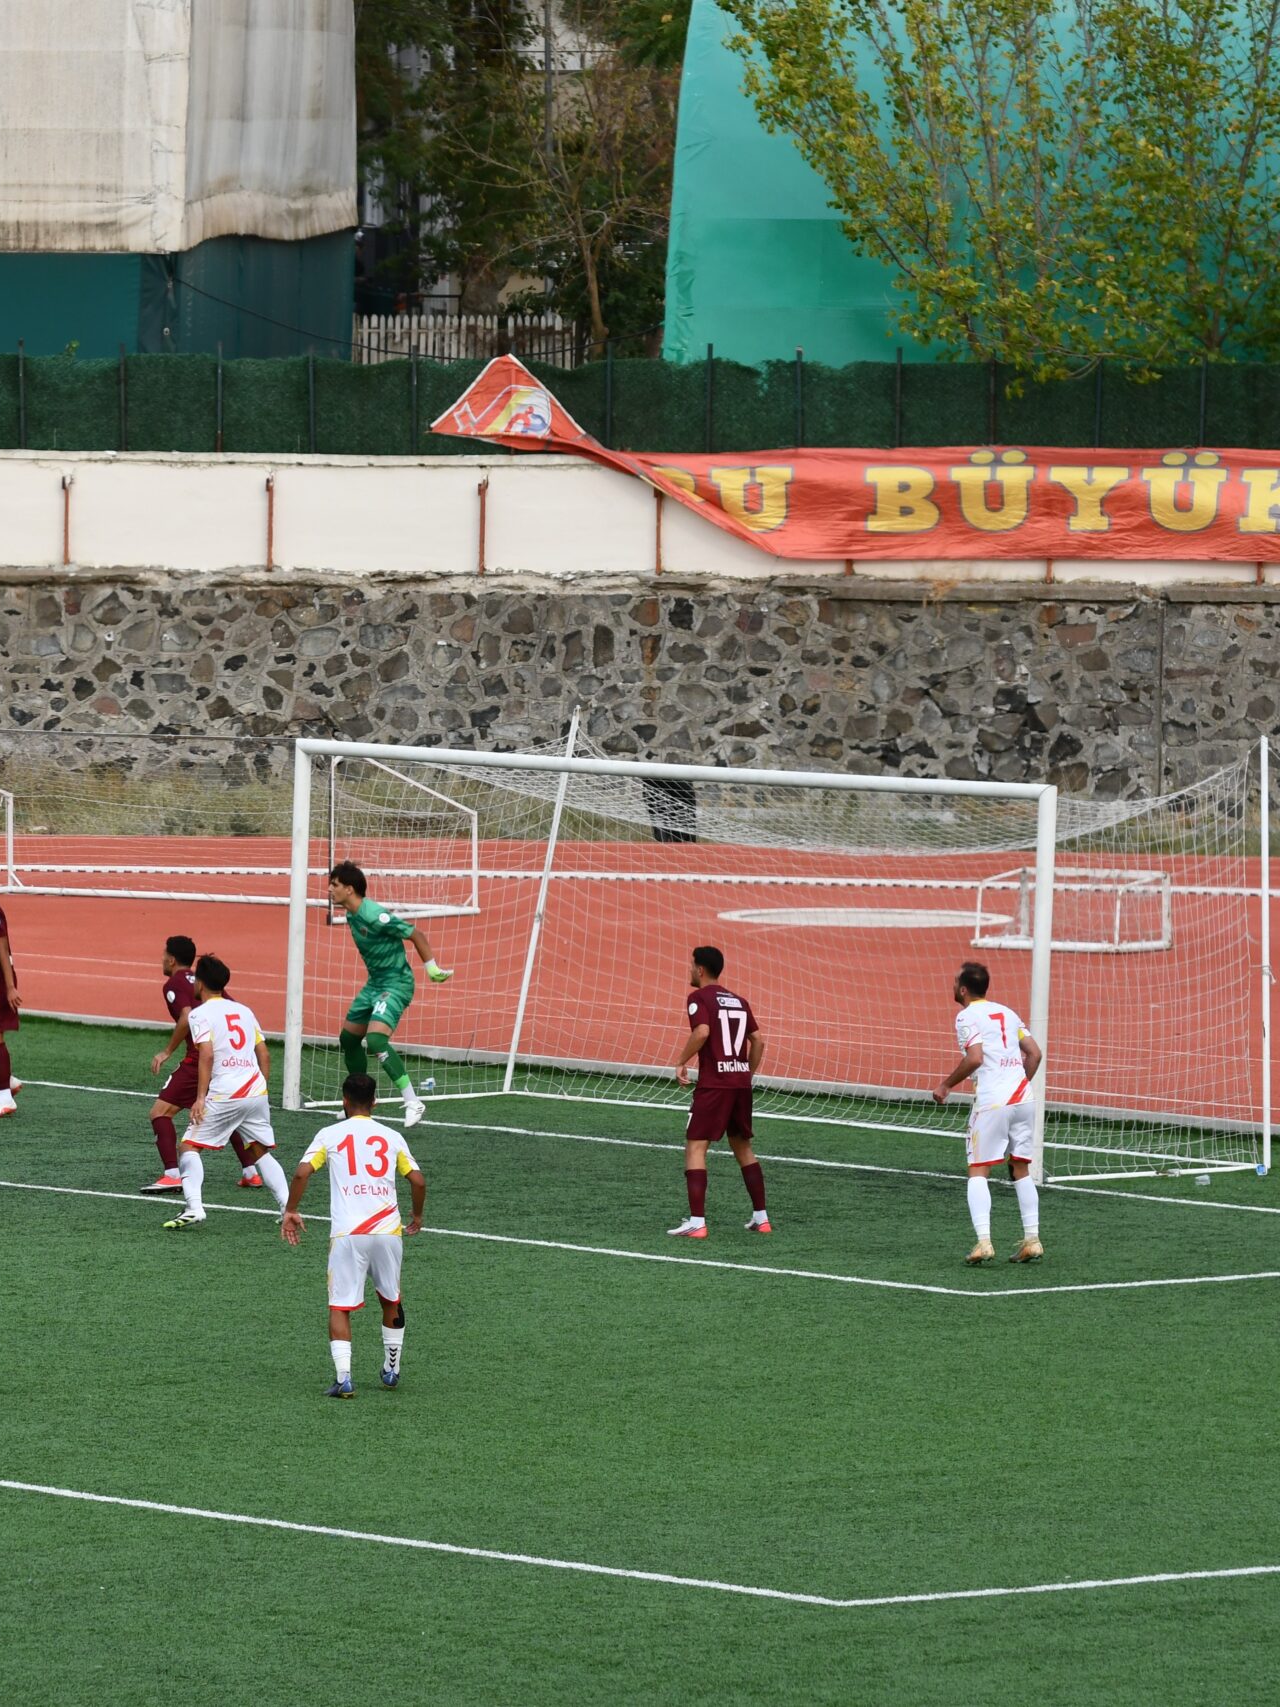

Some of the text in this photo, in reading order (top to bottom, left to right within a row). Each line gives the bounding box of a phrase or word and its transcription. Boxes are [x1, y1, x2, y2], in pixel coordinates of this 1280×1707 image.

[225, 1014, 246, 1050] 5
[718, 1009, 747, 1056] 17
[988, 1012, 1007, 1049] 7
[337, 1134, 389, 1178] 13
